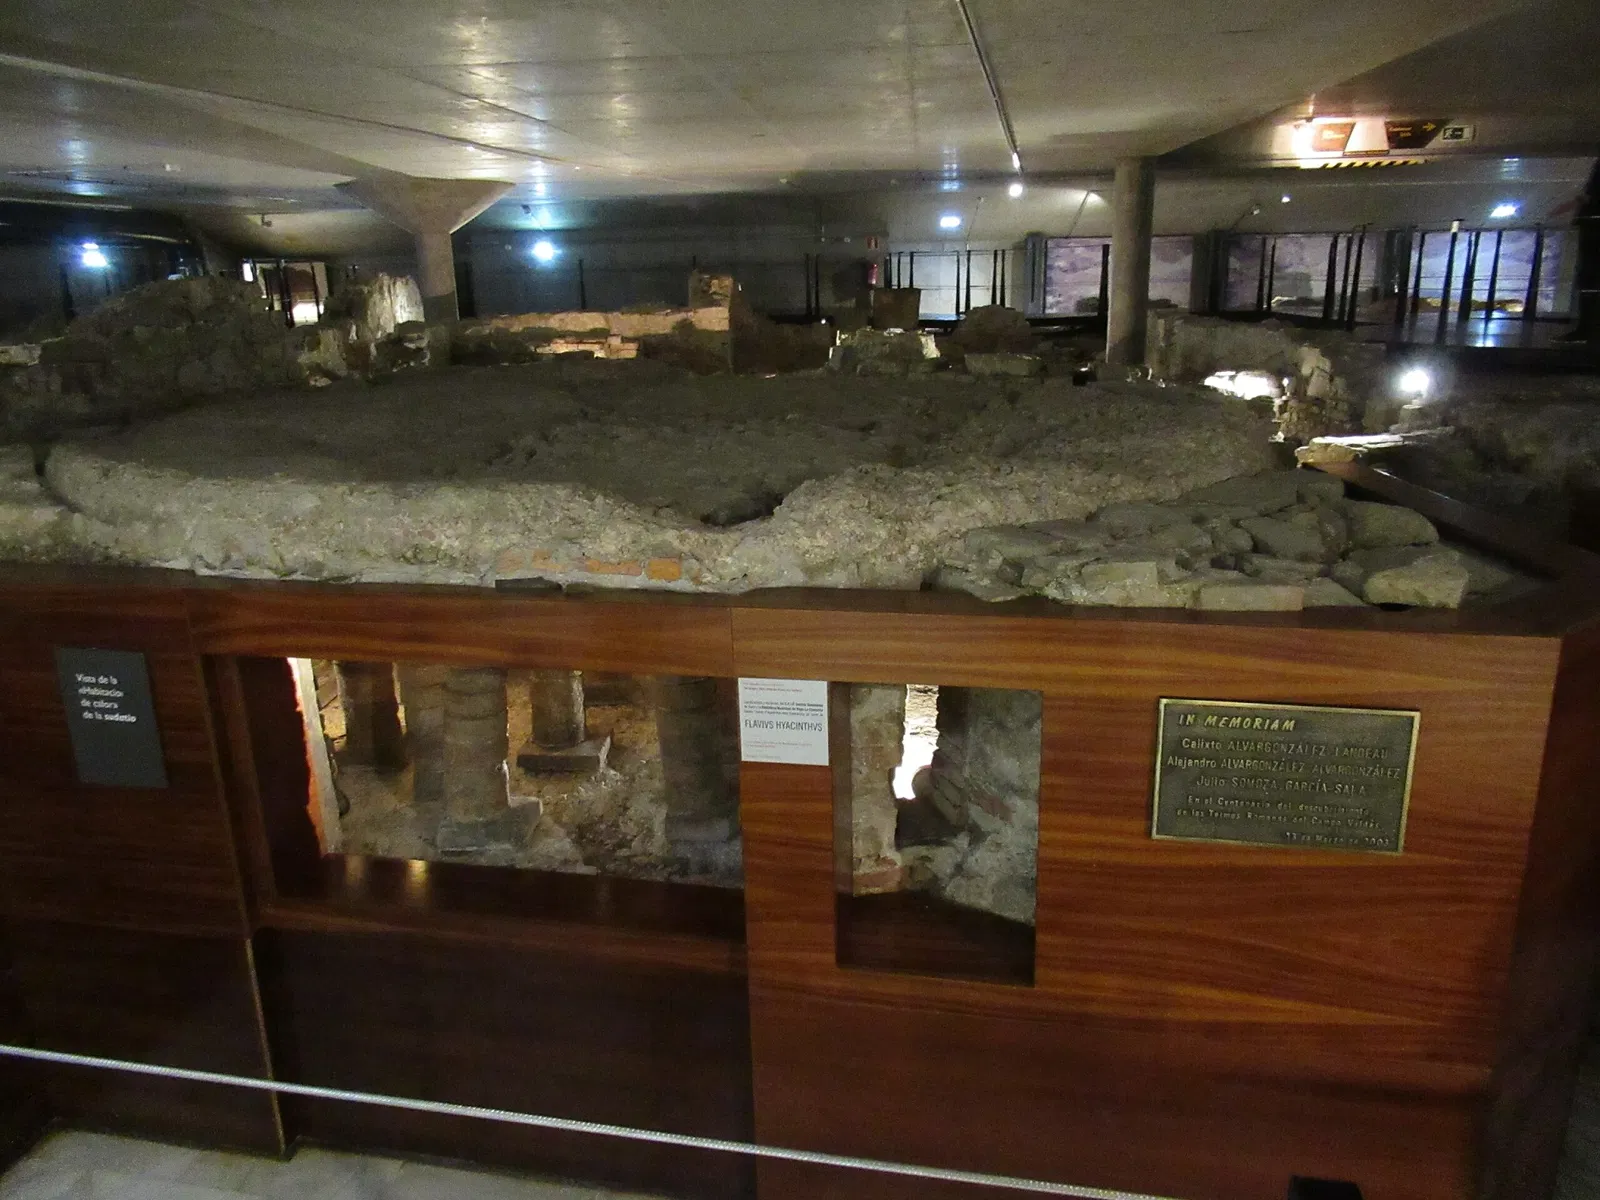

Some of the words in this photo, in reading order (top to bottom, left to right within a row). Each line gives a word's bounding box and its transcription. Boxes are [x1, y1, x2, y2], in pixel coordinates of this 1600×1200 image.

[75, 674, 96, 683] Vista
[98, 675, 109, 685] de
[109, 675, 118, 685] la
[81, 698, 91, 707] de
[83, 711, 93, 719] de
[94, 711, 103, 720] la
[744, 719, 774, 730] FLAVIVS
[775, 720, 823, 732] HYACINTHVS
[1178, 714, 1196, 726] IN
[1204, 714, 1296, 732] MEMORIAM
[1181, 737, 1222, 750] Calixto
[1167, 755, 1217, 770] Alejandro
[1196, 776, 1226, 787] Julio
[1188, 795, 1201, 805] En
[1204, 797, 1213, 805] el
[1177, 808, 1188, 817] de
[1192, 809, 1205, 818] las
[1209, 809, 1241, 820] Termas
